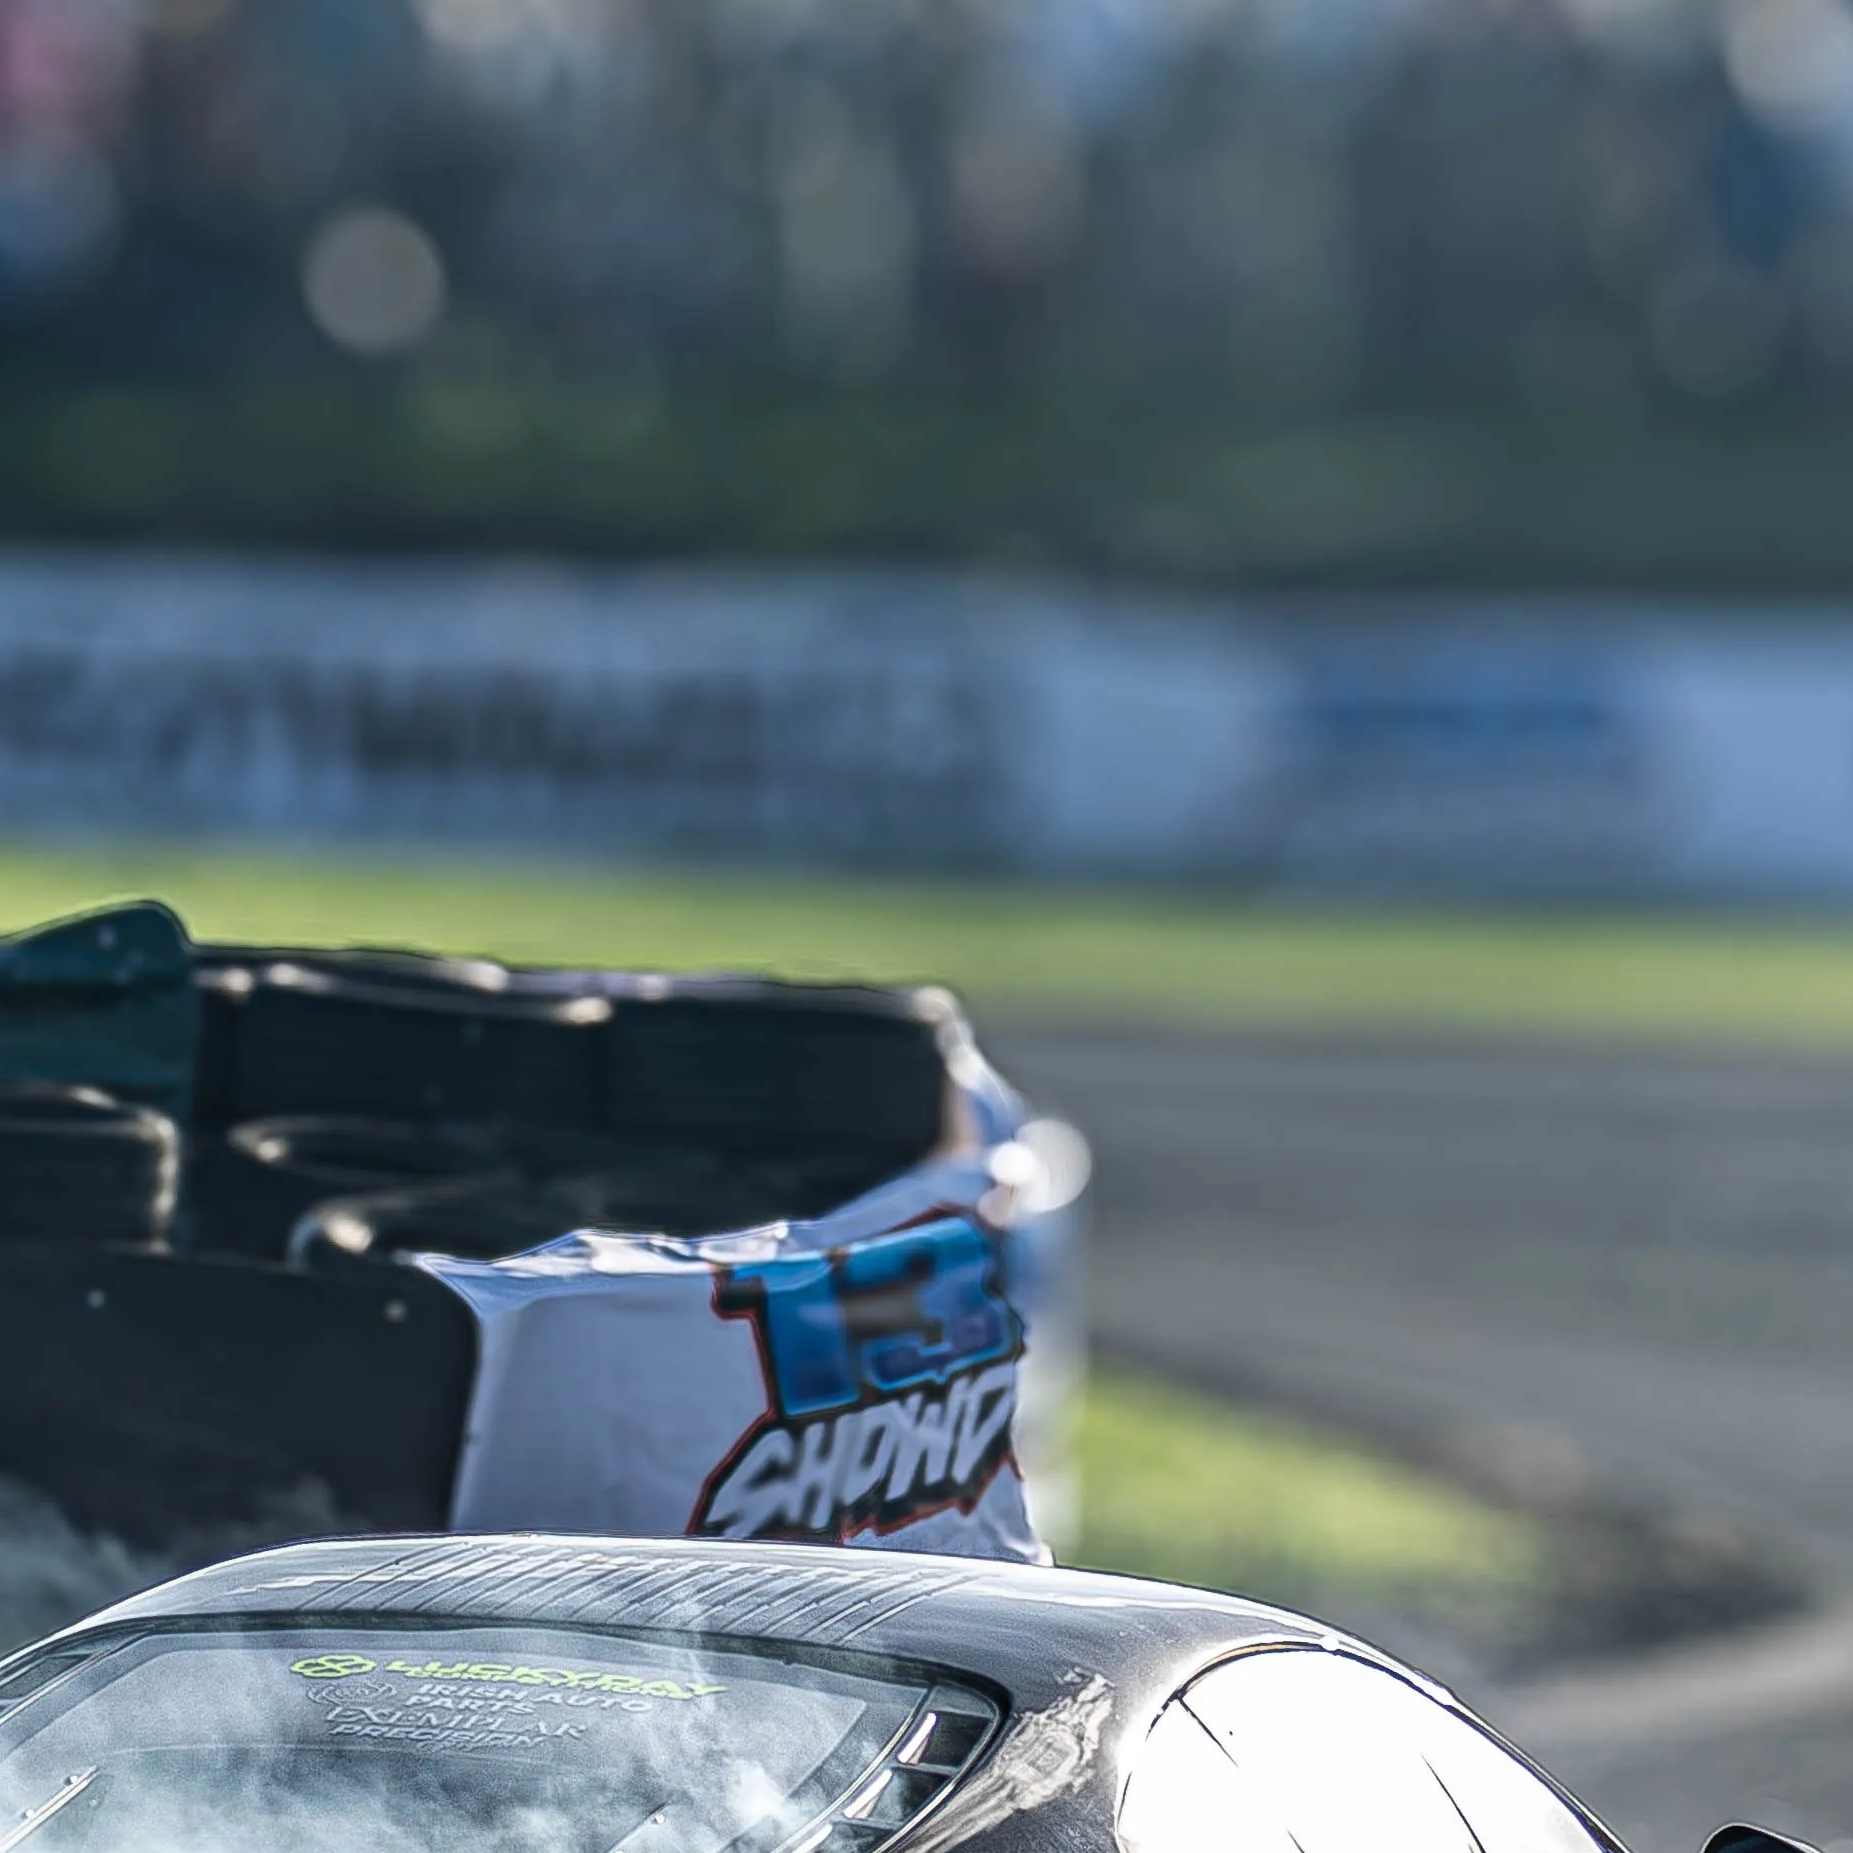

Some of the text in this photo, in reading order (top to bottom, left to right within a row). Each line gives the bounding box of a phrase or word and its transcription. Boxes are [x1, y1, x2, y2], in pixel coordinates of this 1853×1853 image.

[404, 1694, 536, 1715] PARTS
[417, 1683, 528, 1701] IRISH
[533, 1691, 654, 1712] AUTO
[325, 1705, 587, 1739] EXEMPLAR
